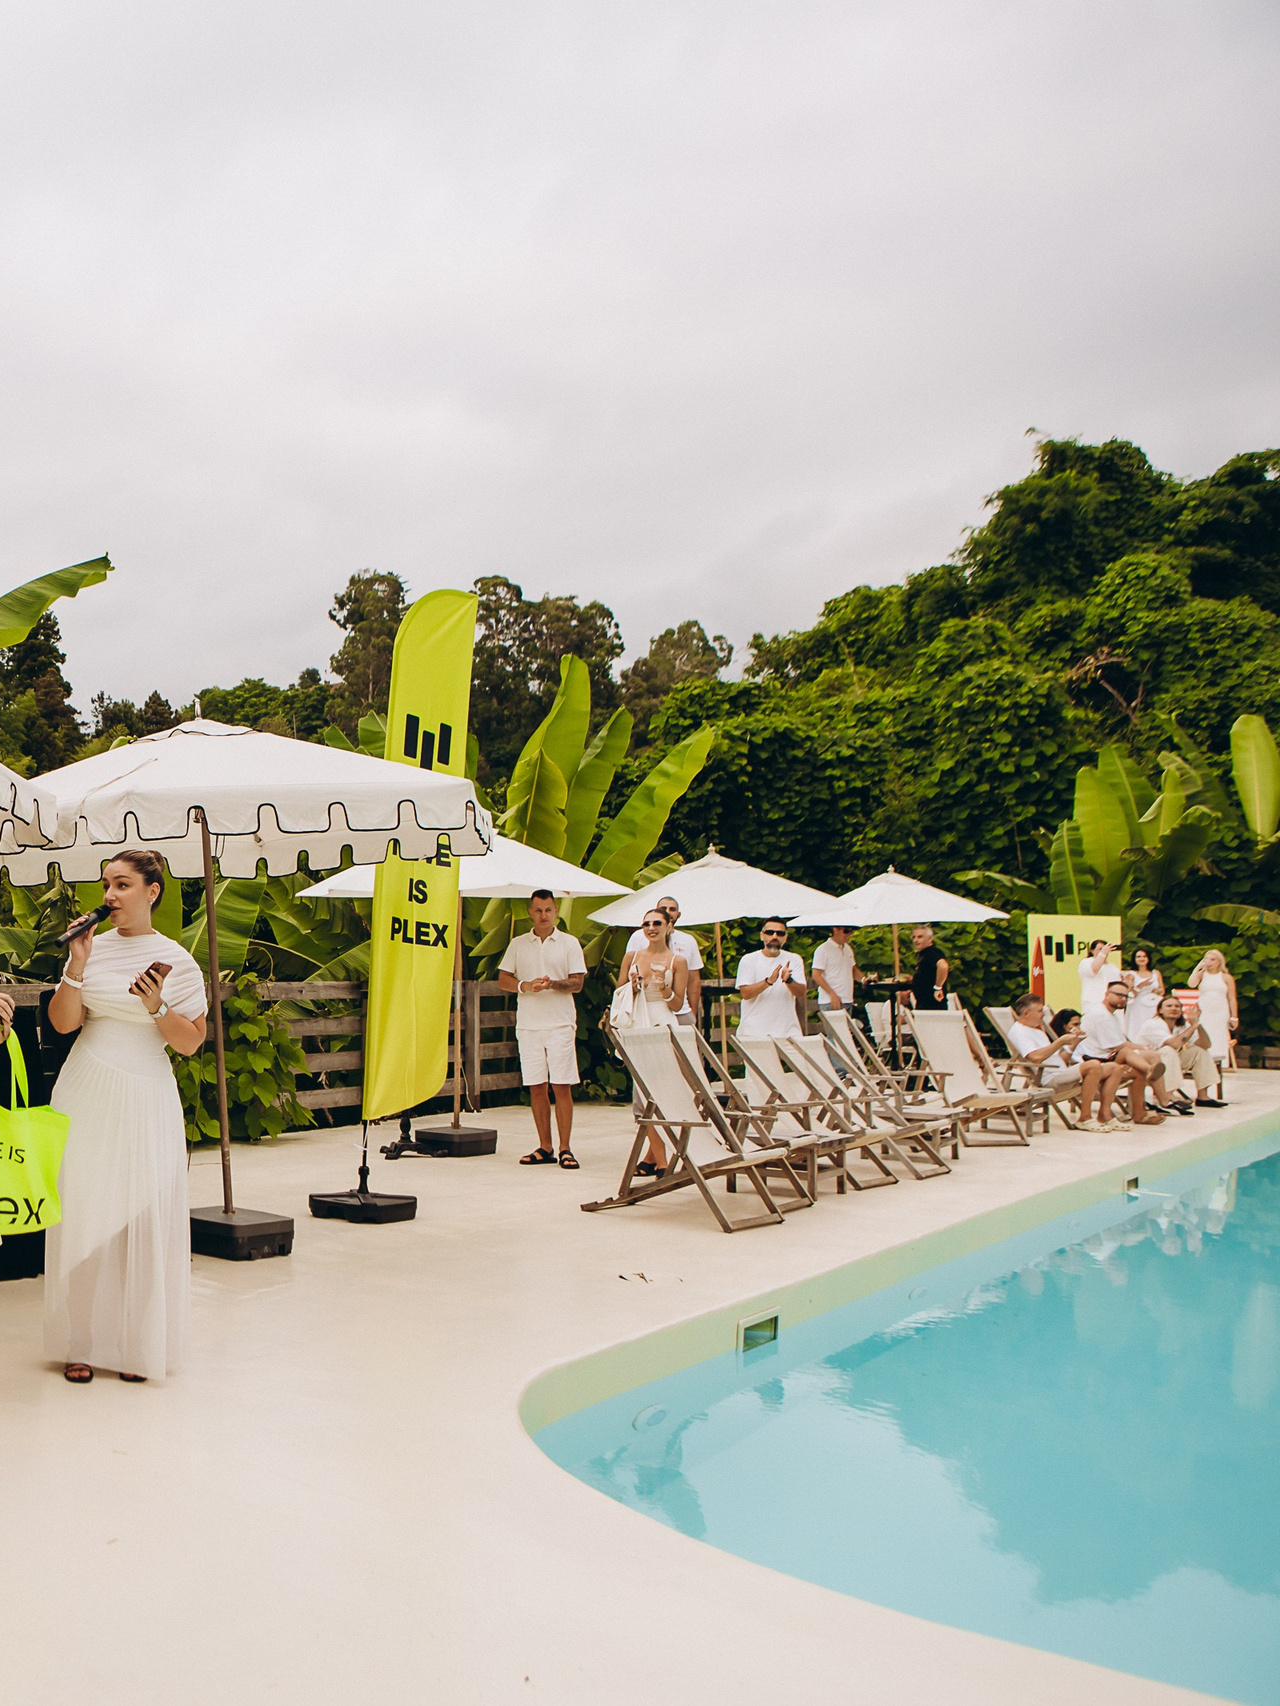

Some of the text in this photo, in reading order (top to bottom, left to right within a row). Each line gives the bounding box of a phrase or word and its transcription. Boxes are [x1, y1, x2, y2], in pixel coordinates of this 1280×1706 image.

[408, 878, 428, 904] IS
[390, 916, 449, 948] PLEX
[8, 1146, 25, 1164] IS
